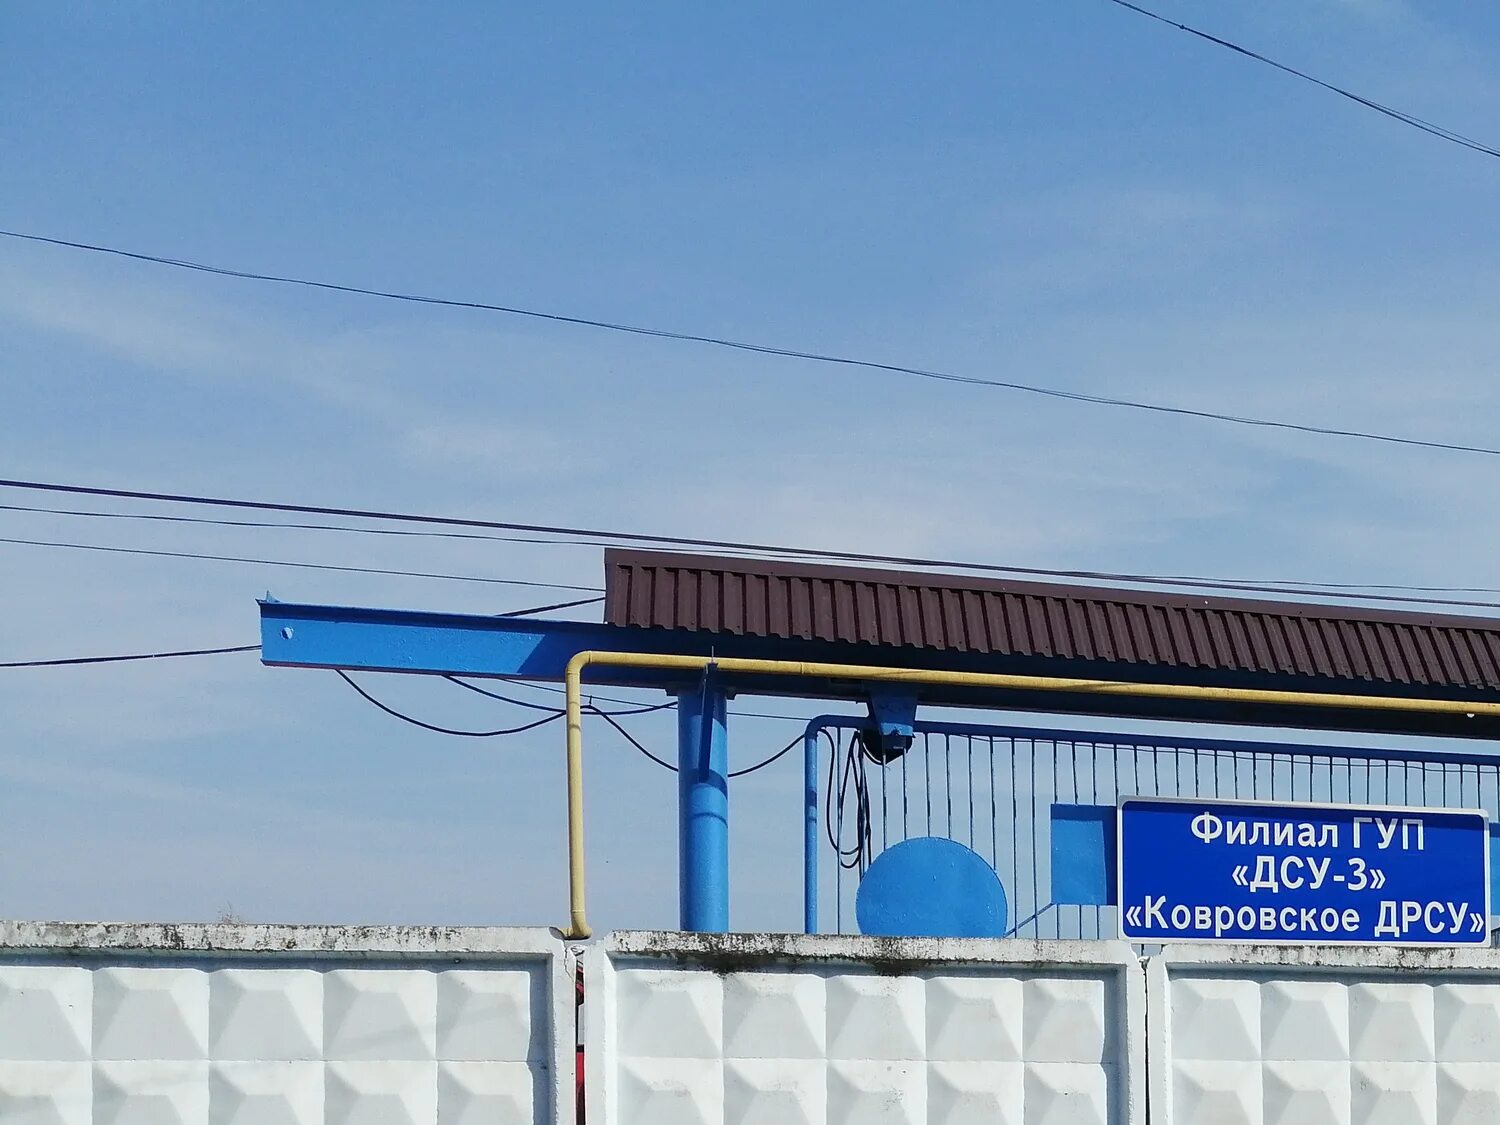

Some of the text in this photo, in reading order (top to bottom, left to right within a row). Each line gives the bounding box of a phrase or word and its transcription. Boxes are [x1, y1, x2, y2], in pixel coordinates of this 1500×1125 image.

[1191, 811, 1425, 851] Филиал ГУП
[1232, 855, 1386, 893] «ДСУ-3»
[1126, 895, 1484, 938] «Ковровское ДРСУ»
